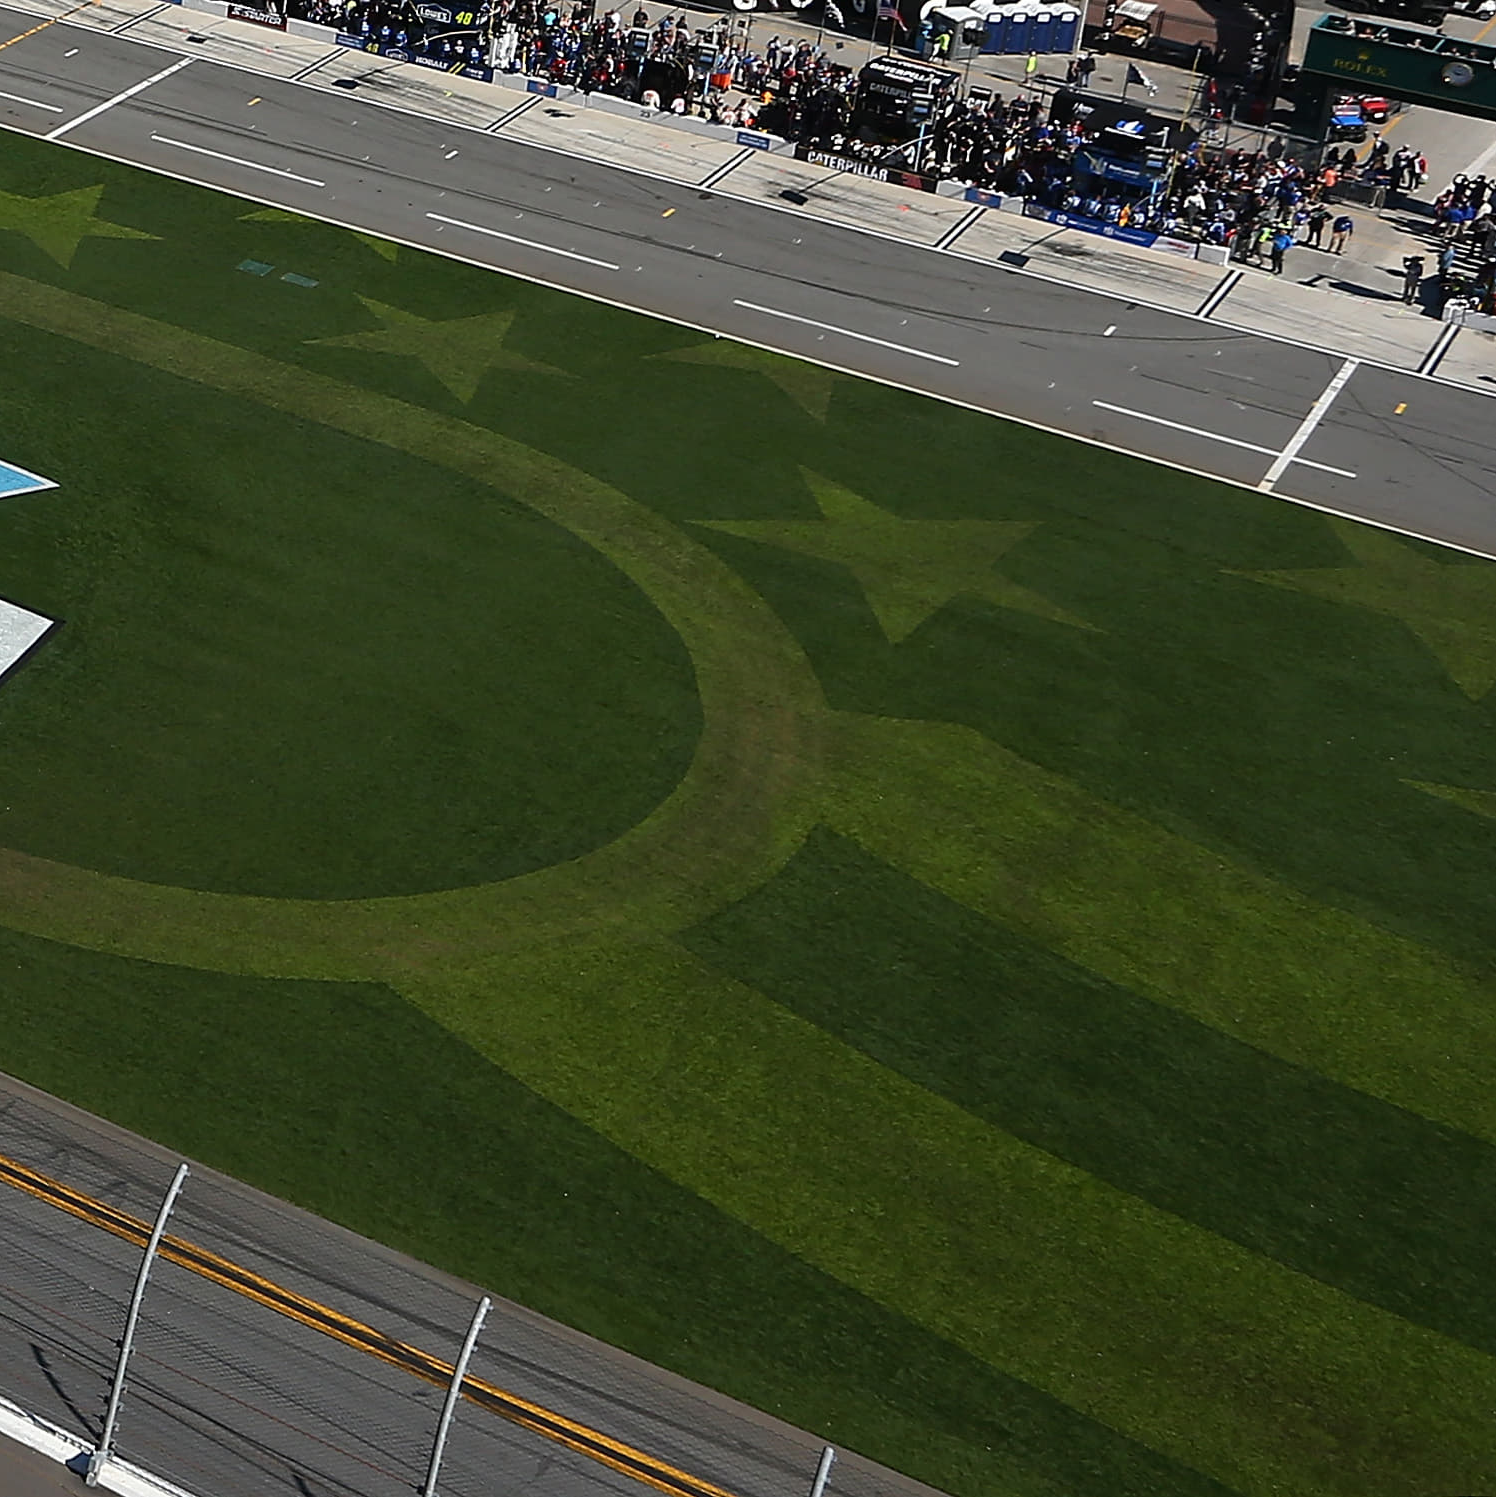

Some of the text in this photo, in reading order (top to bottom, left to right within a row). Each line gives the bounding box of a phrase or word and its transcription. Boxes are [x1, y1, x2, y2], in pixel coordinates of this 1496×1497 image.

[455, 11, 473, 25] 48
[415, 55, 449, 70] KOBALT
[1332, 58, 1388, 79] ROLEX
[869, 62, 942, 85] CATERPILLAR
[869, 82, 912, 98] CATERPILL
[807, 150, 889, 183] CATERPILLAR
